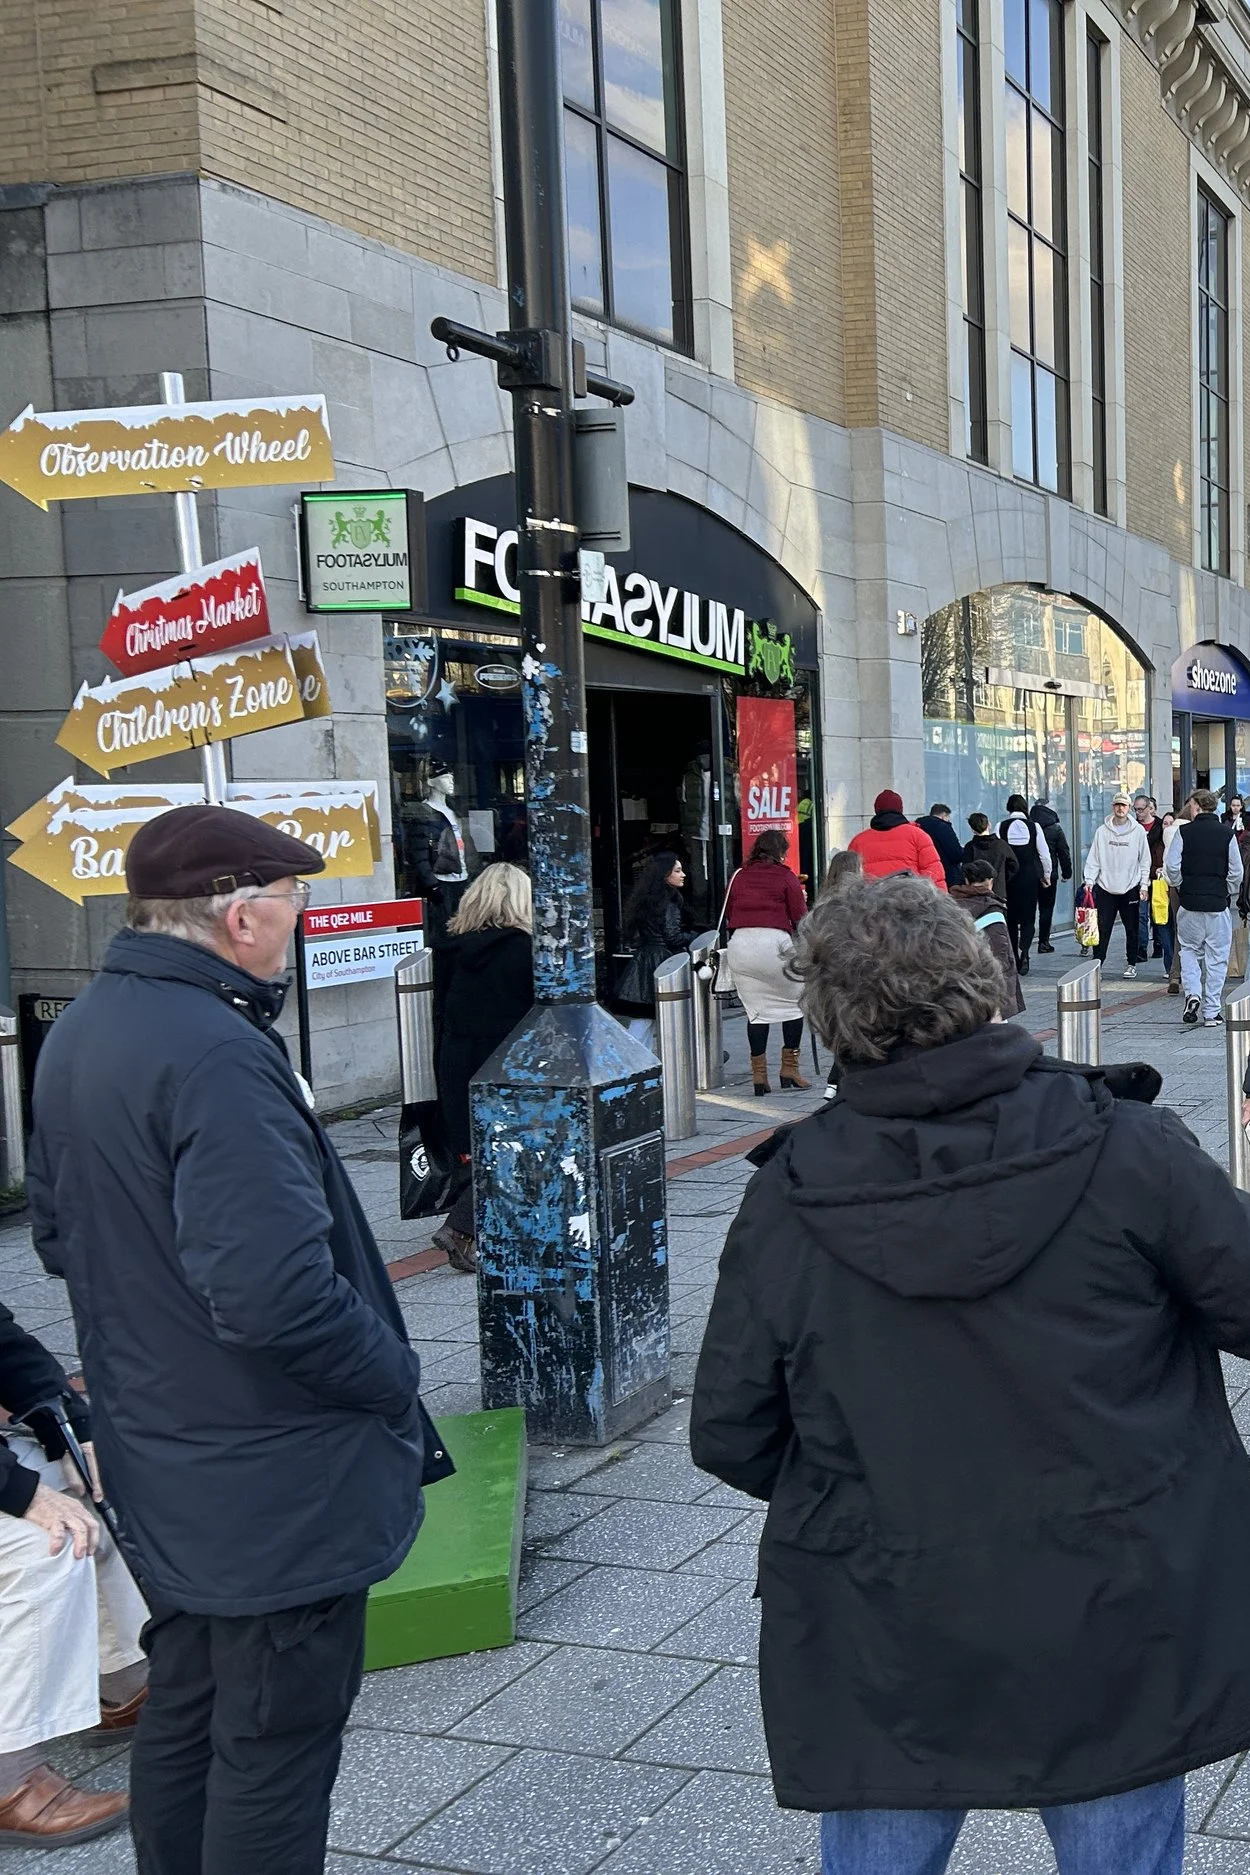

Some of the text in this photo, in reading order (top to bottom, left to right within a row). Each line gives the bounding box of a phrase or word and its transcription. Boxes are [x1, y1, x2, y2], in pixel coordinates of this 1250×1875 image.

[40, 428, 312, 478] Observation Wheel
[316, 552, 408, 568] FOOTASYLUM
[322, 581, 405, 592] SOUTHAMPTON
[464, 517, 745, 666] FOASYLUM
[125, 582, 262, 657] Christmas Market
[1191, 659, 1237, 695] shoezone
[96, 695, 223, 754] Childrens
[225, 674, 294, 719] Zone
[747, 785, 792, 820] SALE
[309, 910, 373, 929] THE QE2 MILE
[312, 940, 419, 968] ABOVE BAR STREET
[312, 965, 376, 981] City of Southampton
